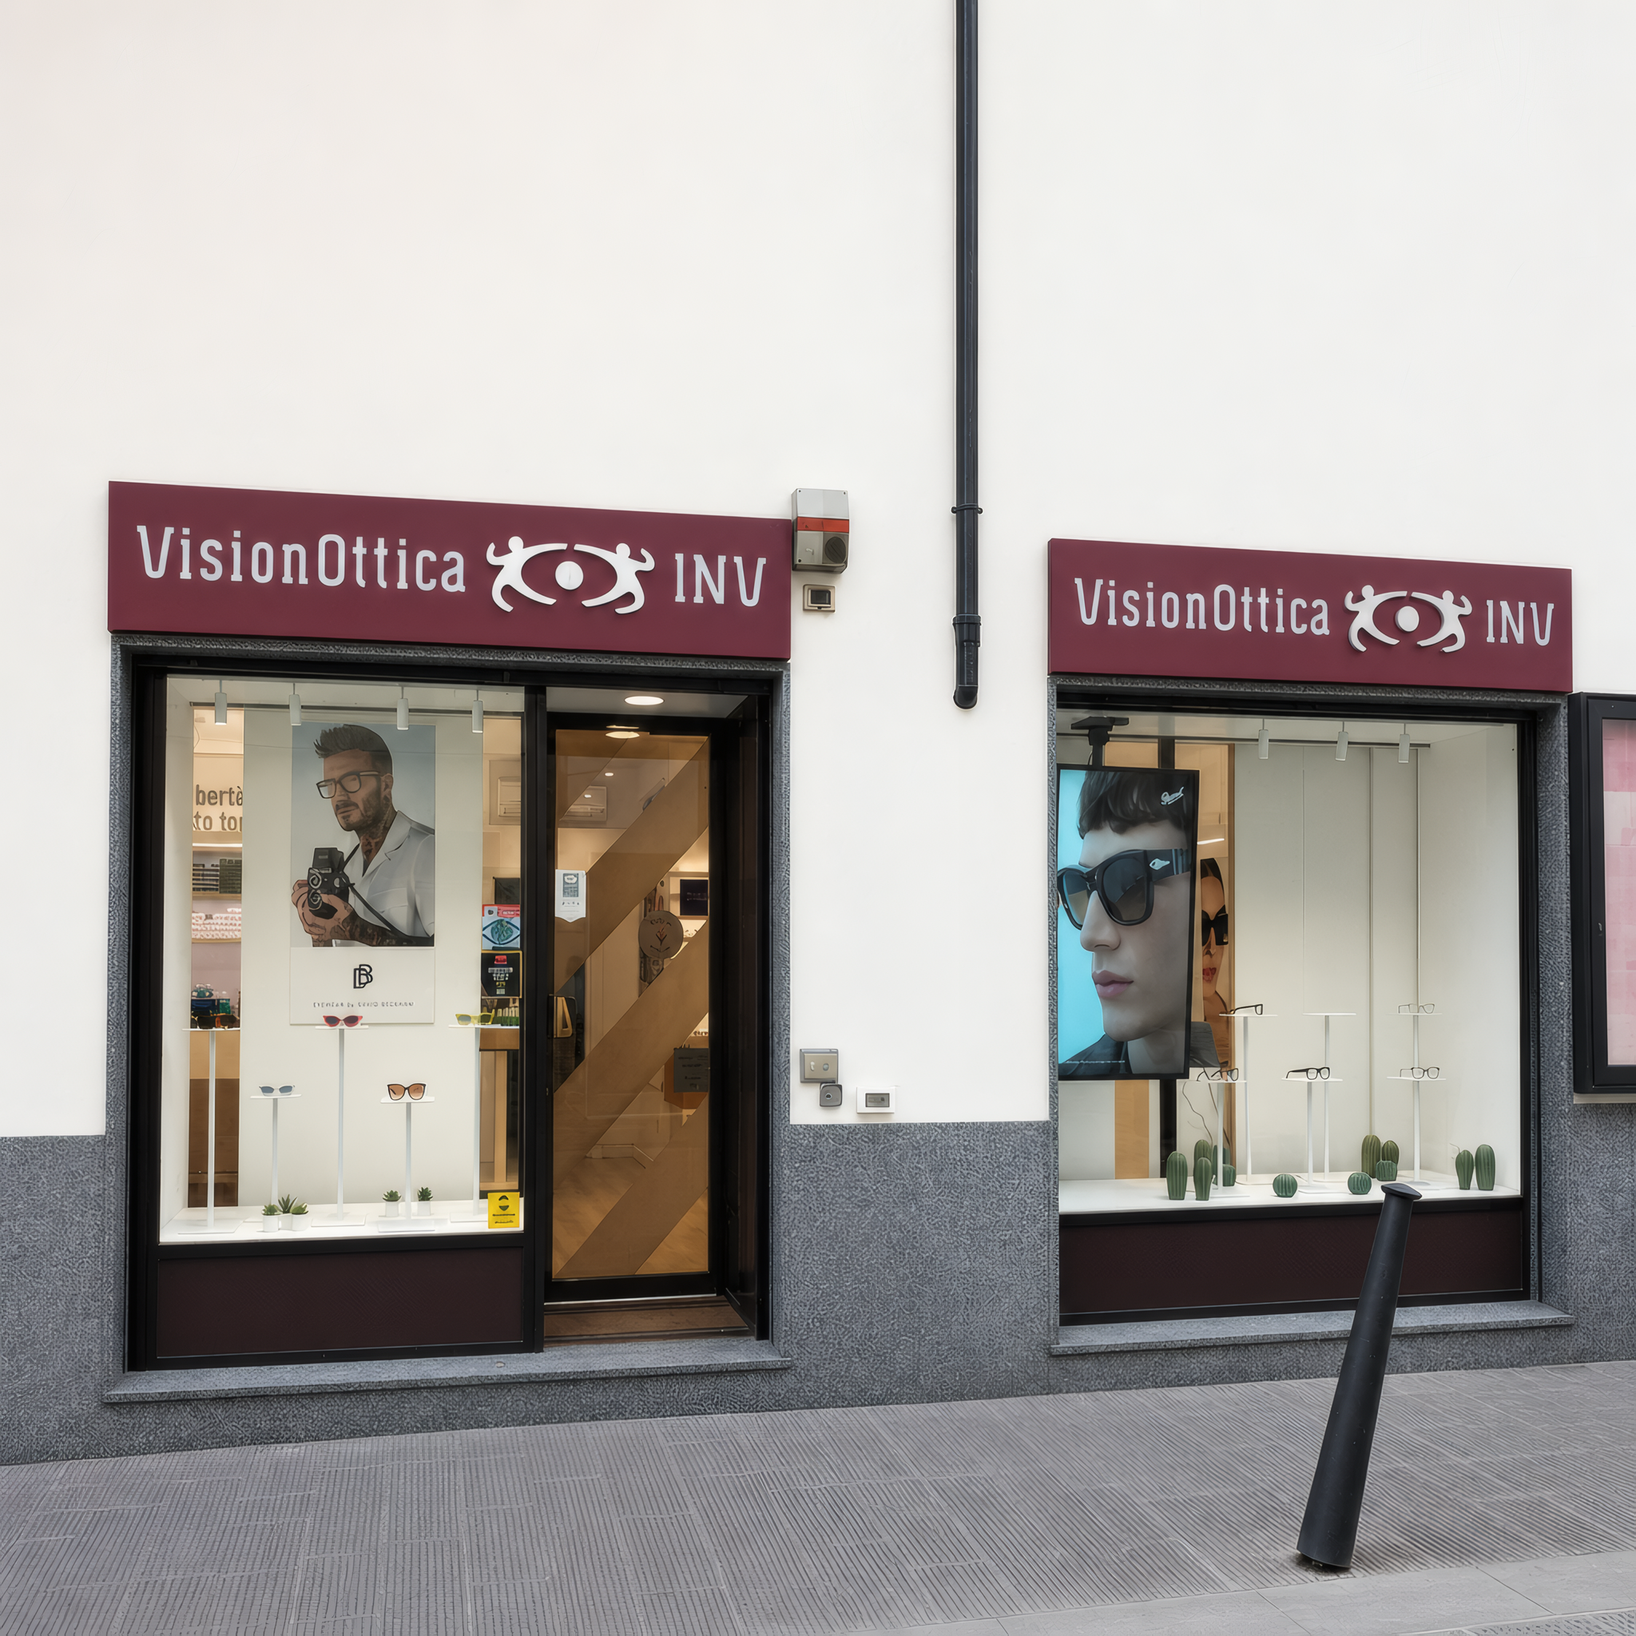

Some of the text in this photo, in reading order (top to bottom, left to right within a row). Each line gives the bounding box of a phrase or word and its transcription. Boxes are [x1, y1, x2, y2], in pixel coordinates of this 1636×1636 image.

[136, 525, 767, 607] VisionOttica INV
[1074, 577, 1555, 647] VisionOttica INV
